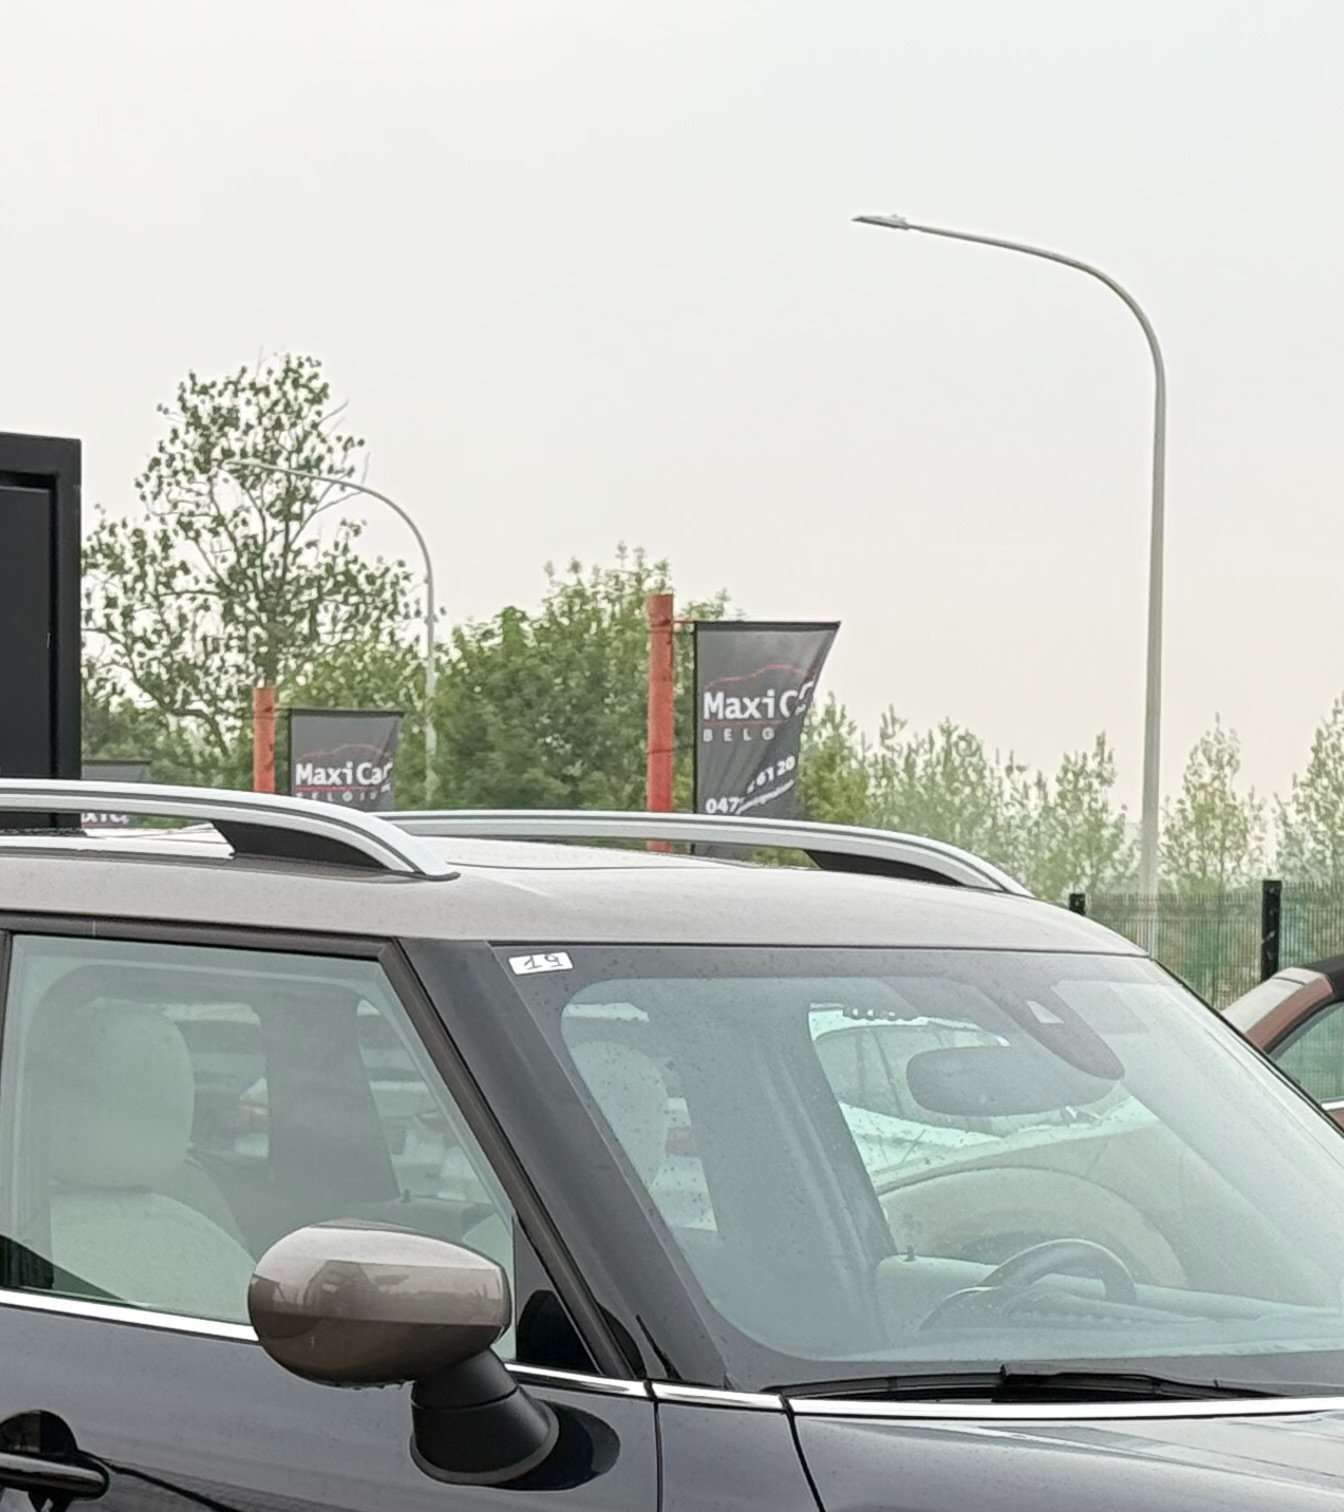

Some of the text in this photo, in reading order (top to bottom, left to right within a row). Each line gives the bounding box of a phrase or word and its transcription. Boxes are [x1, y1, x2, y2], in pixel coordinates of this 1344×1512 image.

[703, 689, 776, 721] Maxi
[295, 761, 354, 786] Maxi
[706, 796, 745, 814] 047
